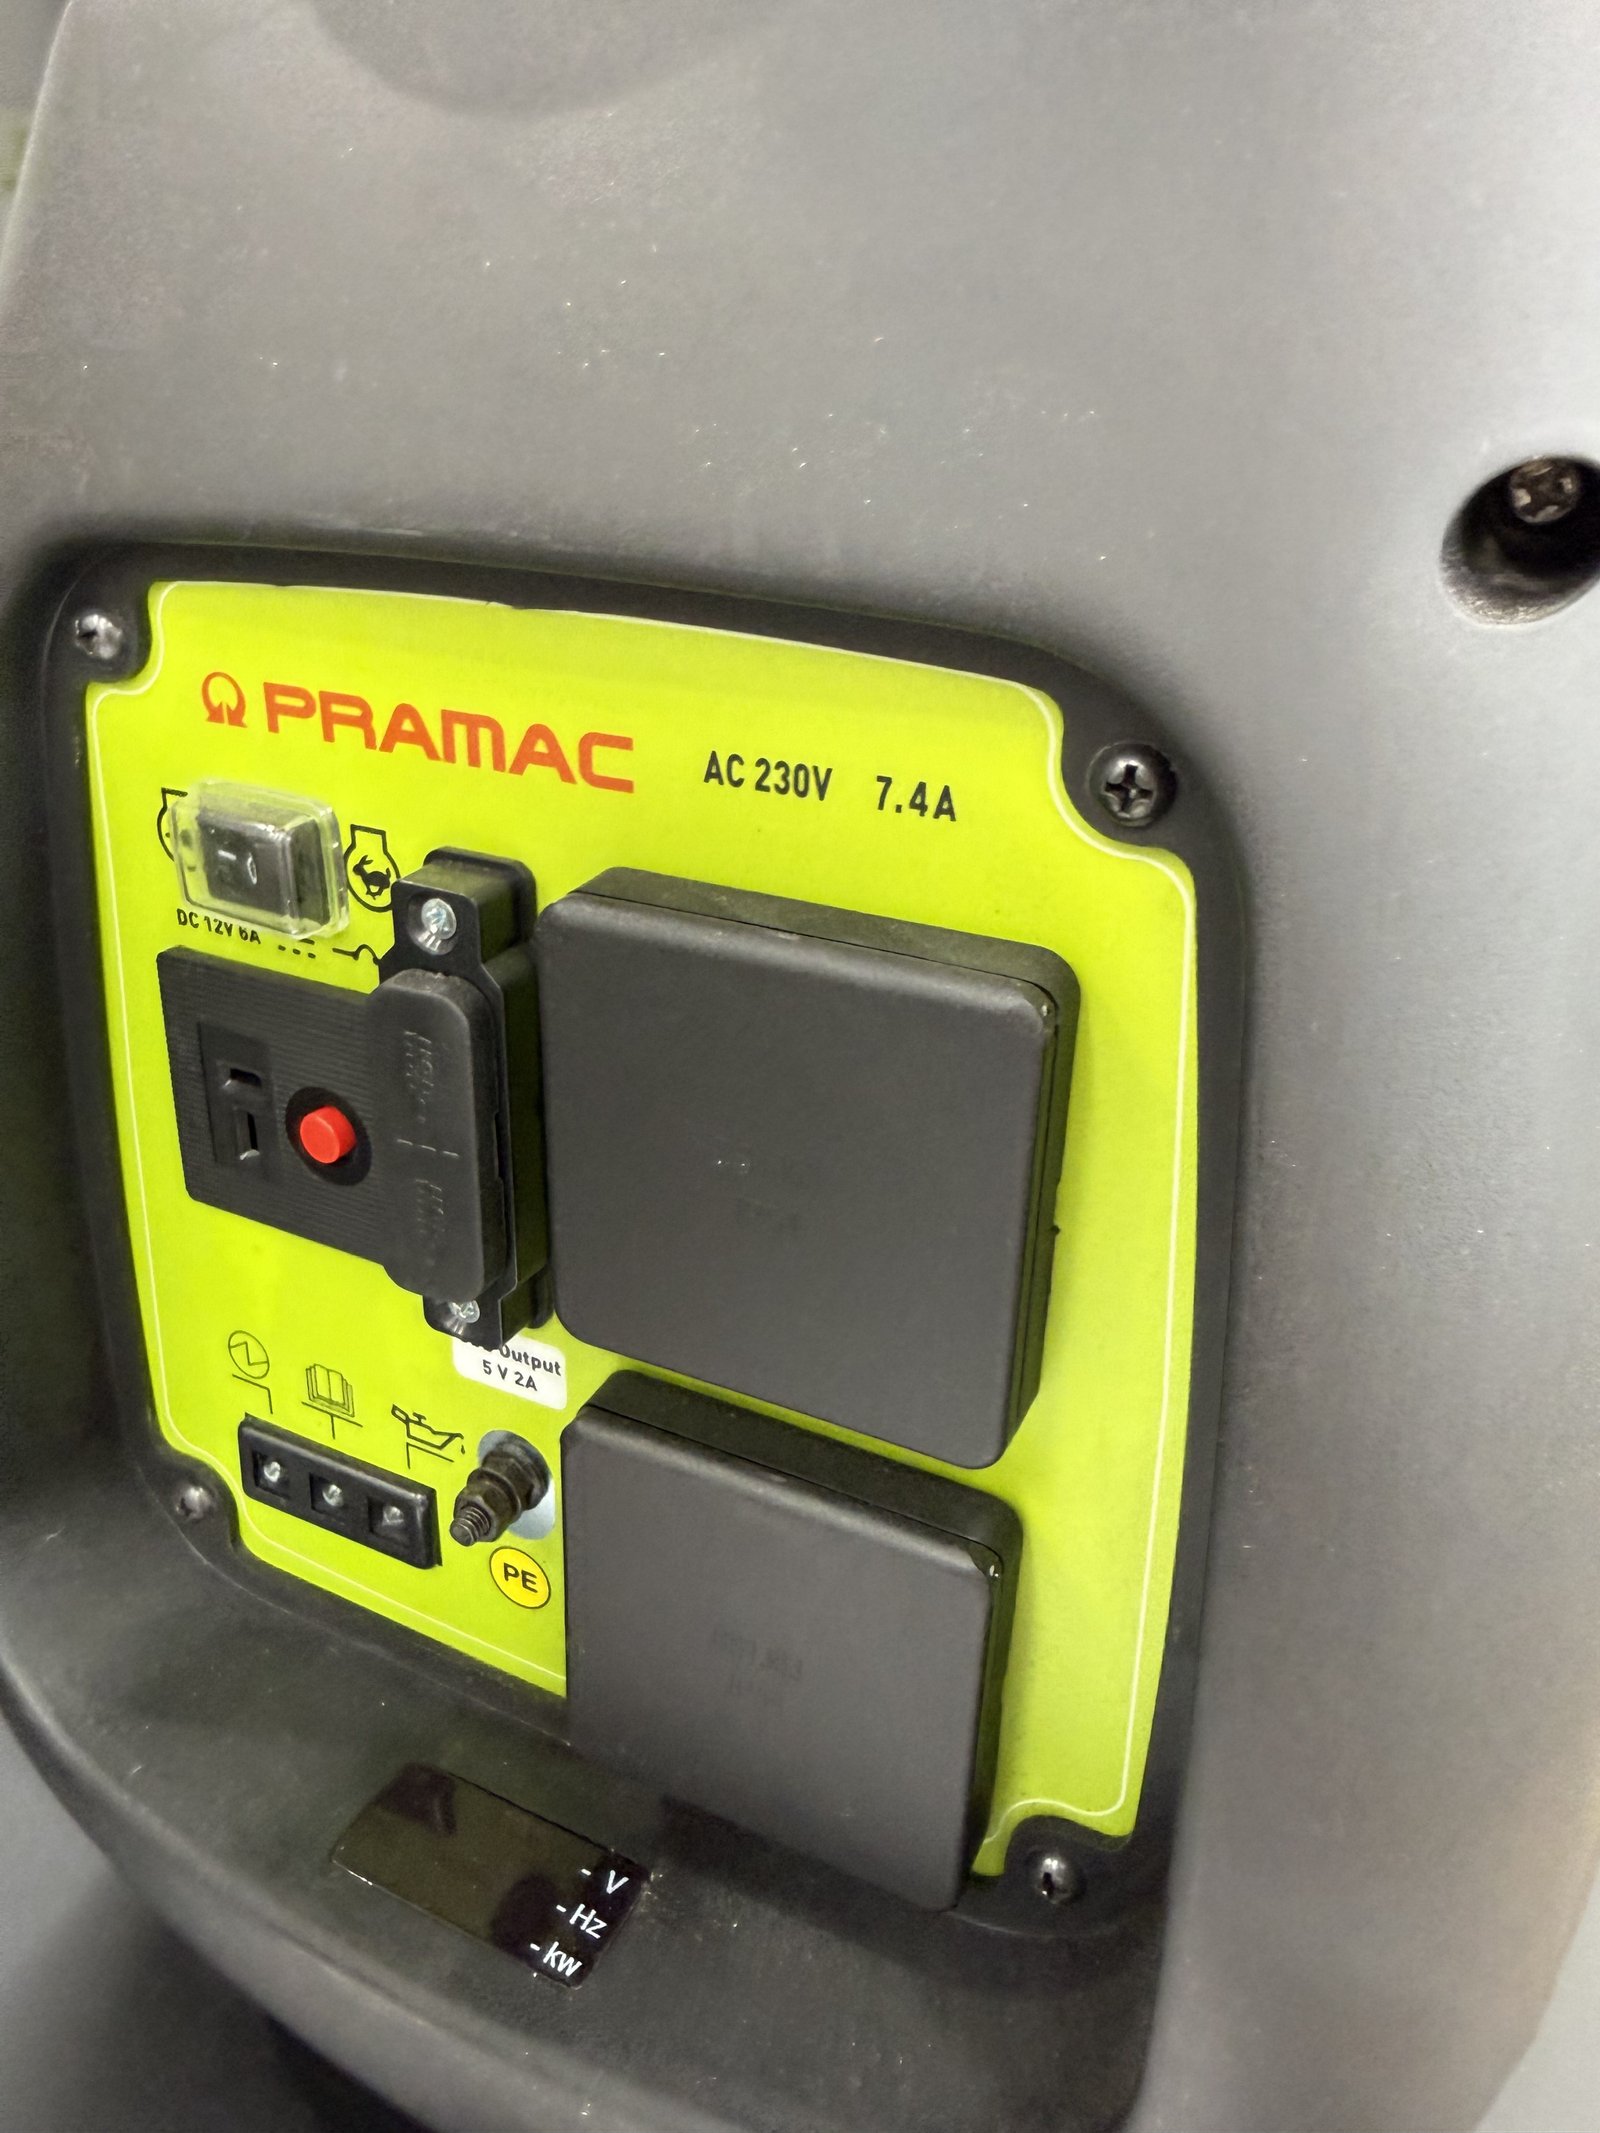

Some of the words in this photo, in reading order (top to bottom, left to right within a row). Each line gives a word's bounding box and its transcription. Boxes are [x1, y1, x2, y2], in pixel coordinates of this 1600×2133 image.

[262, 681, 635, 794] PRAMAC
[703, 750, 745, 788] AC
[754, 757, 833, 801] 230V
[876, 775, 956, 822] 7.4A
[176, 908, 199, 929] DC
[203, 915, 233, 937] 12V
[238, 925, 262, 945] 6A
[482, 1359, 492, 1375] 5
[497, 1363, 508, 1380] V
[514, 1371, 538, 1392] 2A
[500, 1344, 562, 1377] Output
[503, 1562, 538, 1594] PE
